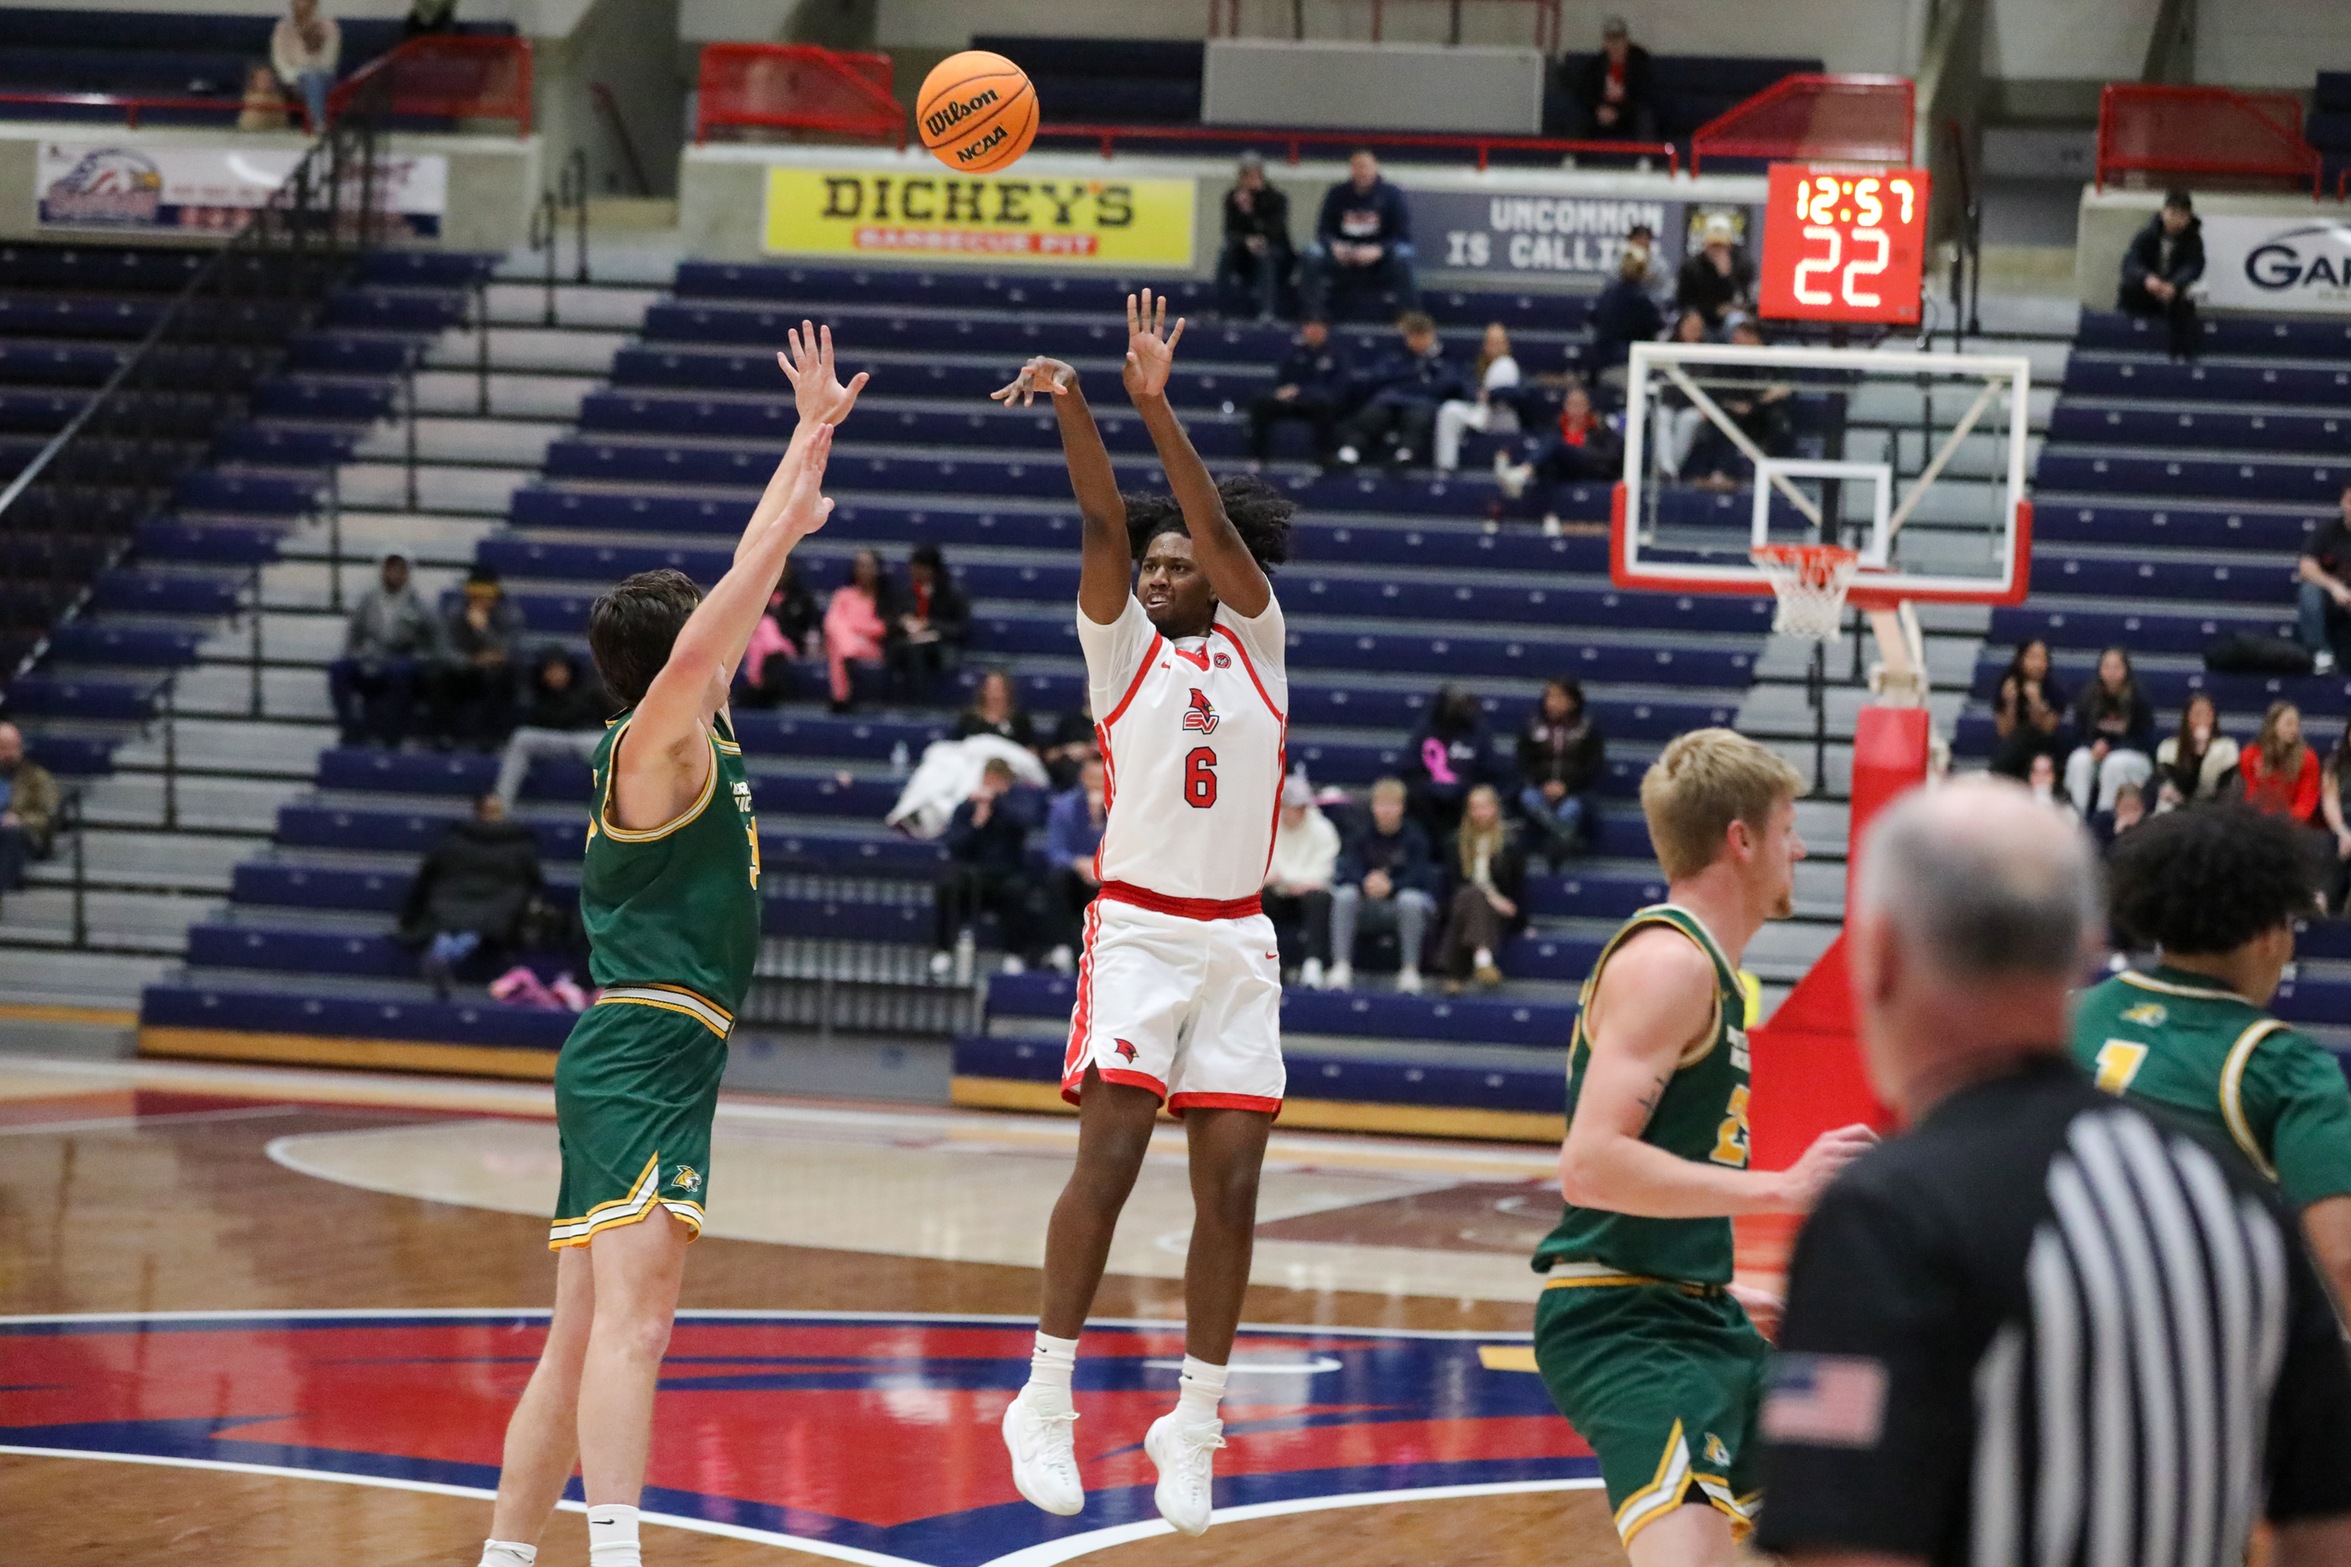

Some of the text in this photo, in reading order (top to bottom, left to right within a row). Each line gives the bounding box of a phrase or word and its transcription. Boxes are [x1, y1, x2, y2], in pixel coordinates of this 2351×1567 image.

[925, 89, 999, 137] Wilson
[956, 125, 1008, 163] NCAA
[822, 176, 1134, 227] DICKEY'S
[1489, 199, 1665, 238] UNCOMMON
[1796, 176, 1915, 227] 12:57
[1447, 231, 1661, 272] IS CALLI
[1793, 225, 1891, 308] 22
[2244, 243, 2351, 291] GA
[1183, 711, 1219, 734] SV
[1184, 746, 1217, 808] 6
